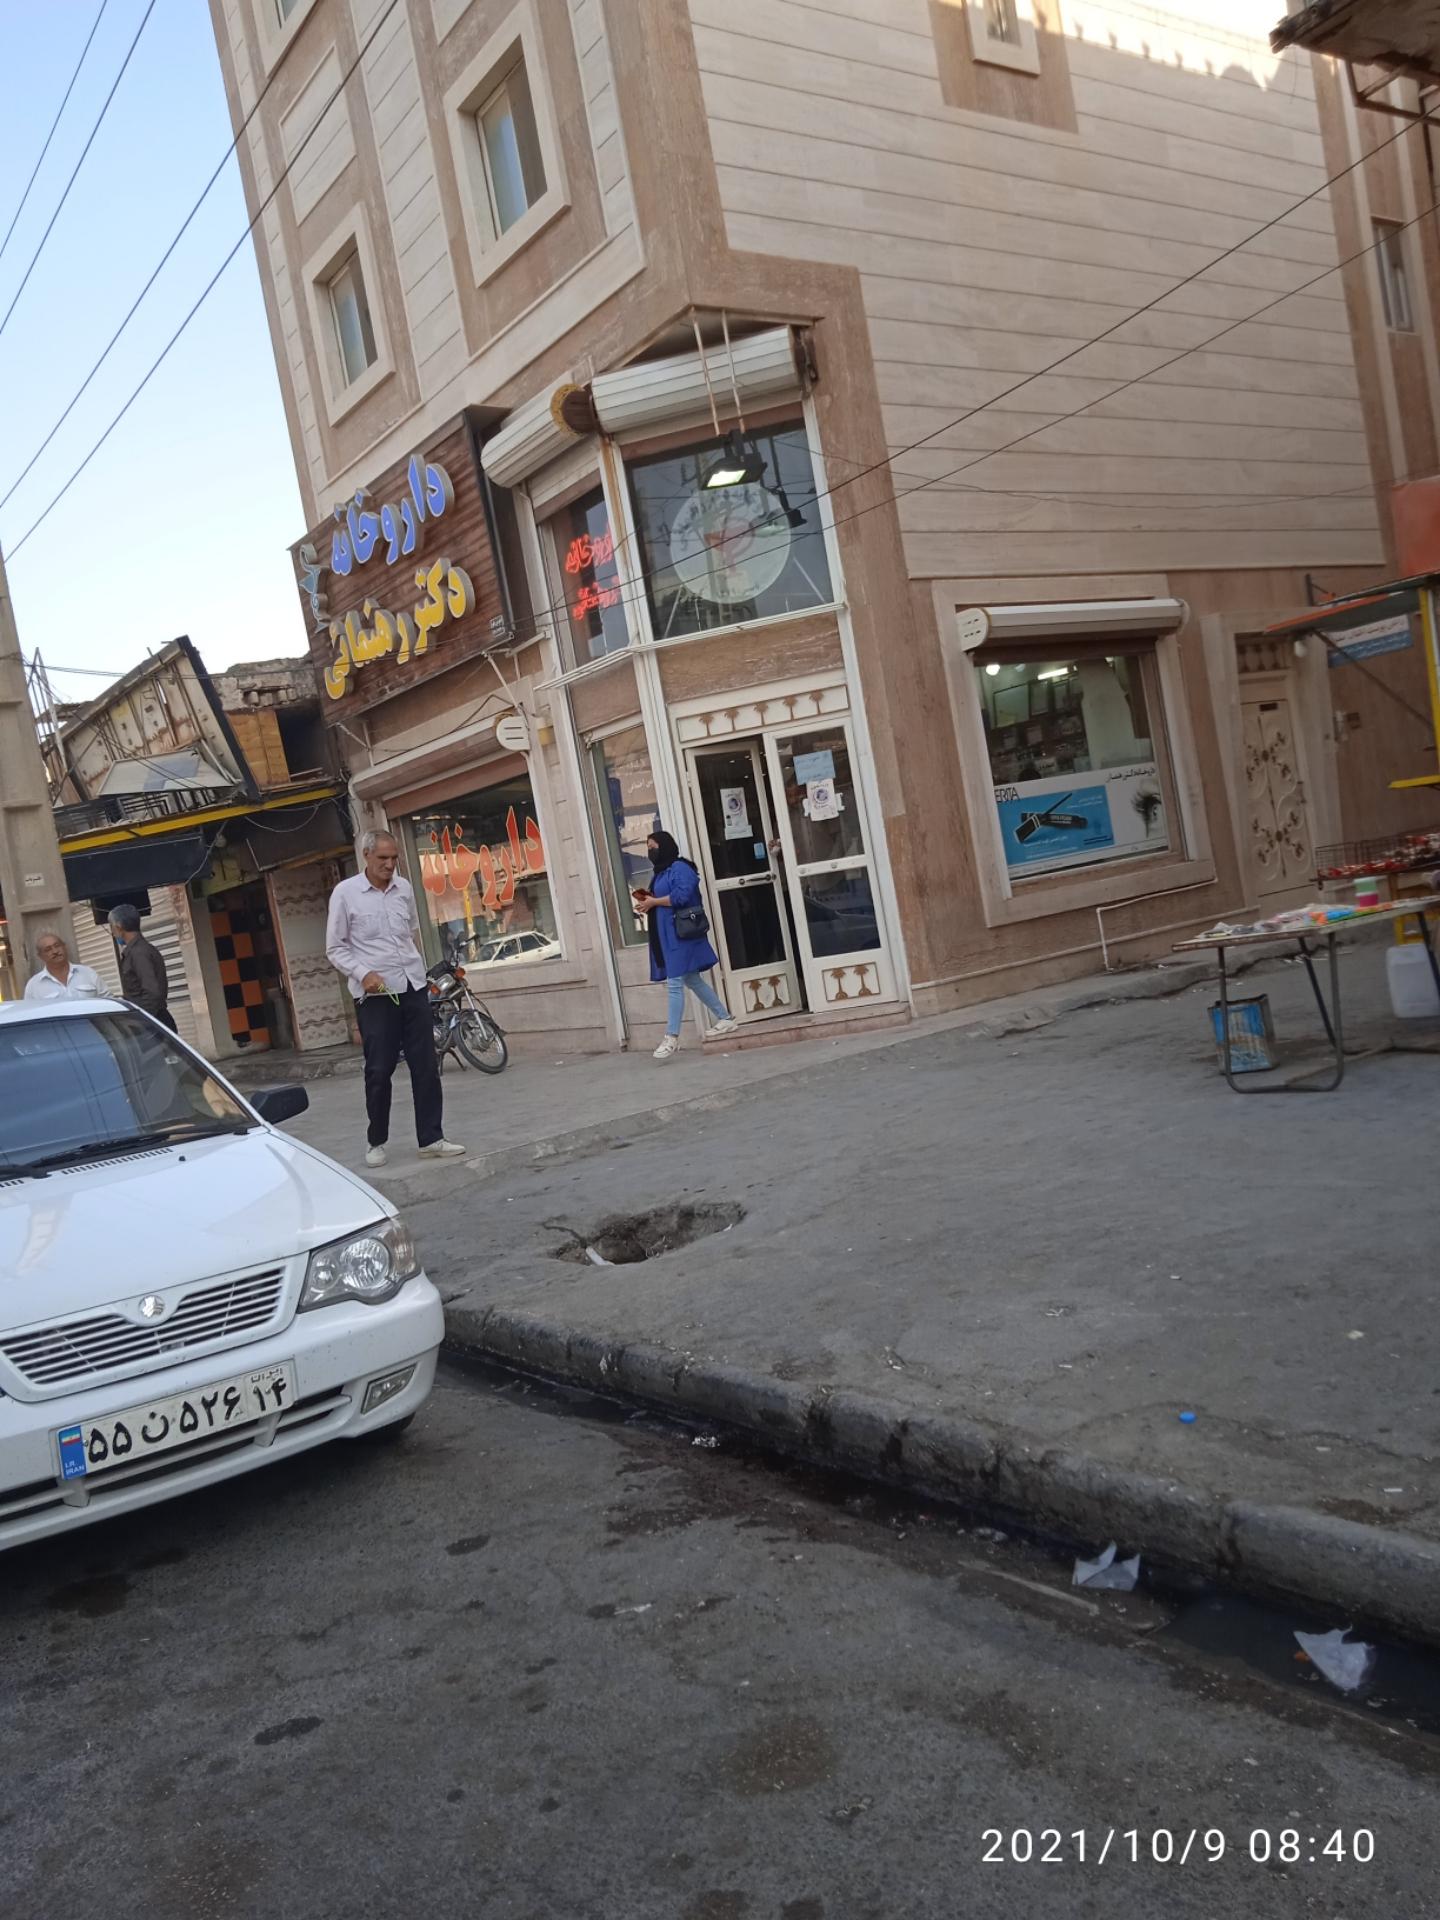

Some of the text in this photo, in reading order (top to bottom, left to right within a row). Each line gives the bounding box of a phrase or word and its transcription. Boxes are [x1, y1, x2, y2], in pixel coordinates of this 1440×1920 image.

[331, 454, 454, 576] داروخانه
[414, 558, 474, 656] دکتر
[422, 806, 545, 906] داروخانه
